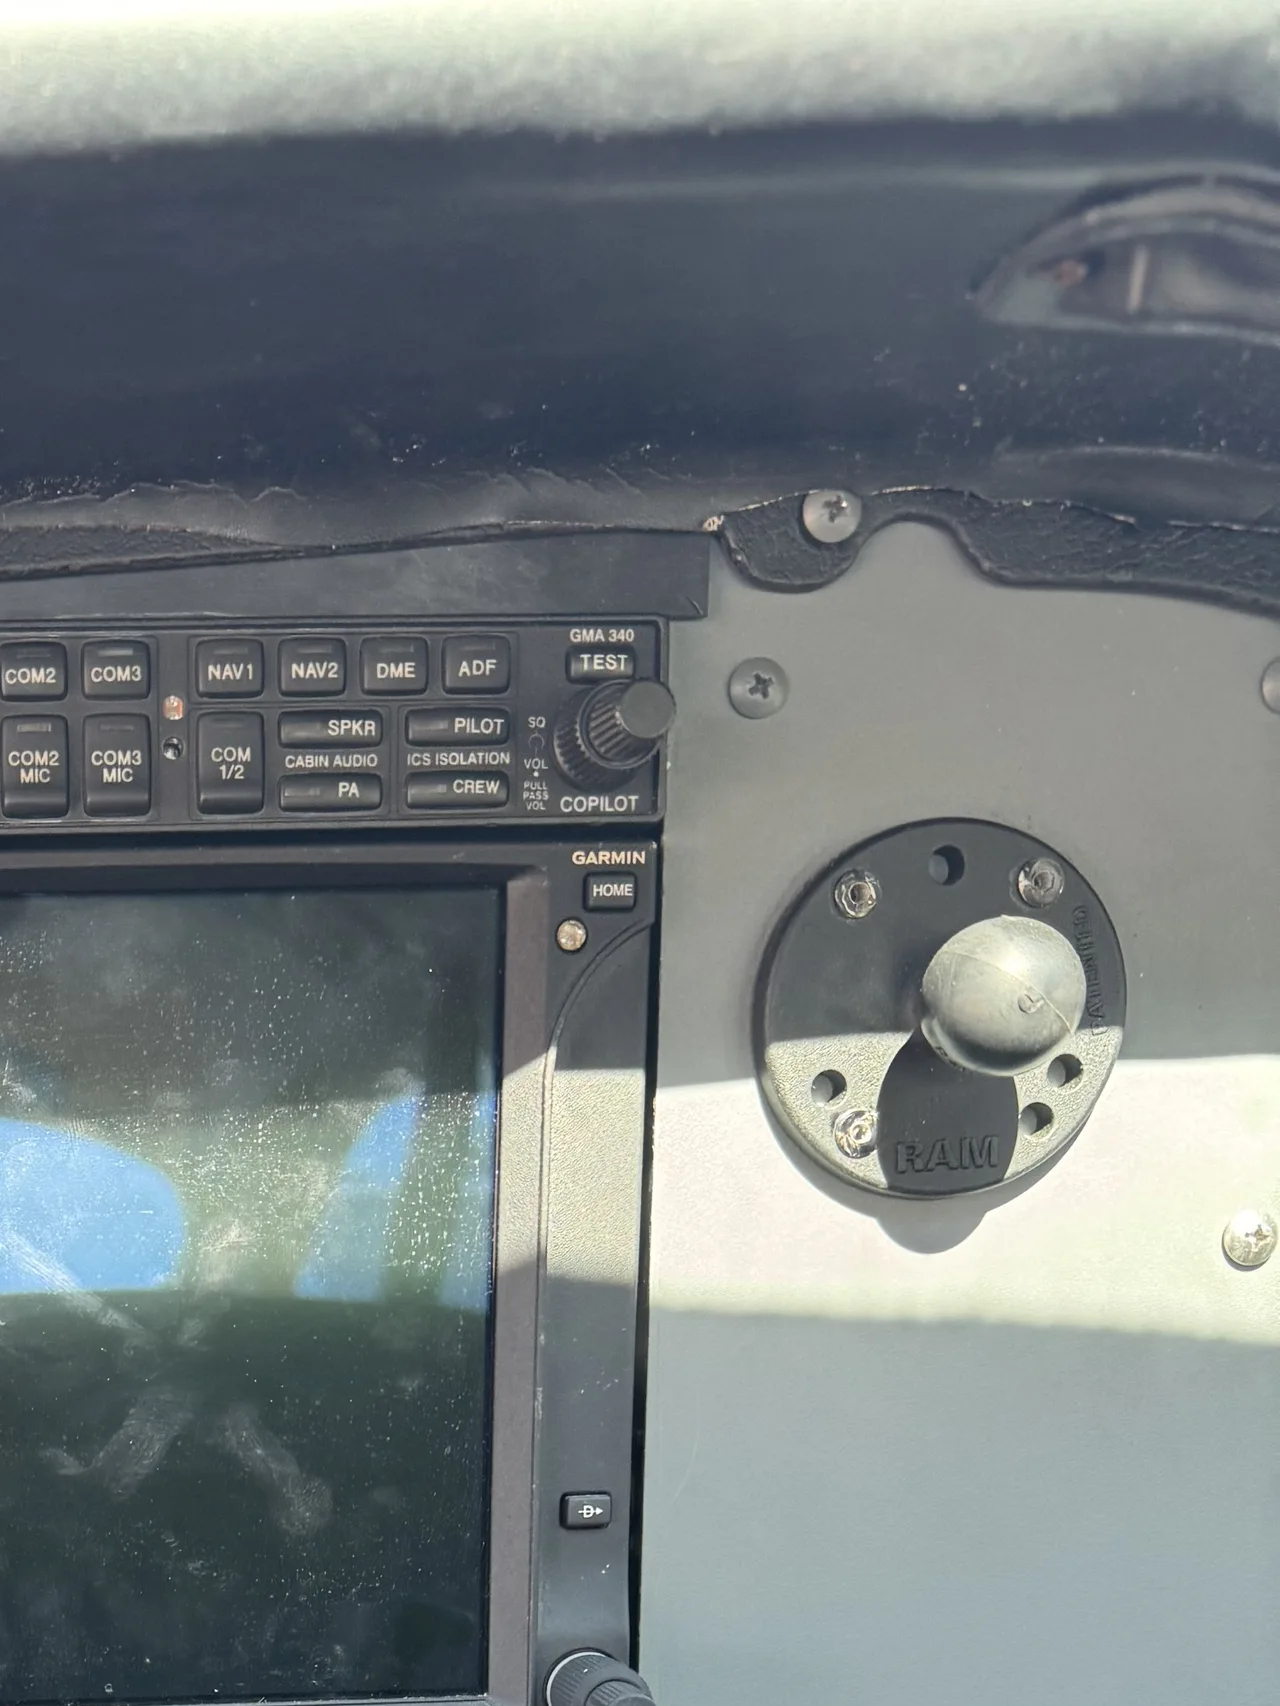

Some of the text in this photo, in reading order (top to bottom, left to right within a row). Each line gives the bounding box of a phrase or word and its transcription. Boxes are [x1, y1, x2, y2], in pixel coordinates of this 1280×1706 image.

[569, 628, 634, 643] GMA 340
[291, 663, 338, 679] NAV2
[376, 664, 415, 678] DME
[458, 660, 497, 677] ADF
[580, 655, 627, 671] TEST
[5, 668, 56, 684] COM2
[90, 666, 141, 682] COM3
[327, 720, 376, 737] SPKR
[454, 718, 504, 734] PILOT
[211, 748, 251, 763] COM
[285, 754, 378, 768] CABIN AUDIO
[407, 751, 510, 766] ICS ISOLATION
[219, 764, 245, 781] 1/2
[338, 783, 360, 798] PA
[453, 779, 500, 795] CREW
[560, 796, 638, 813] COPILOT
[571, 851, 645, 865] GARMIN
[593, 884, 633, 898] HOME
[895, 1134, 1000, 1175] RAM
